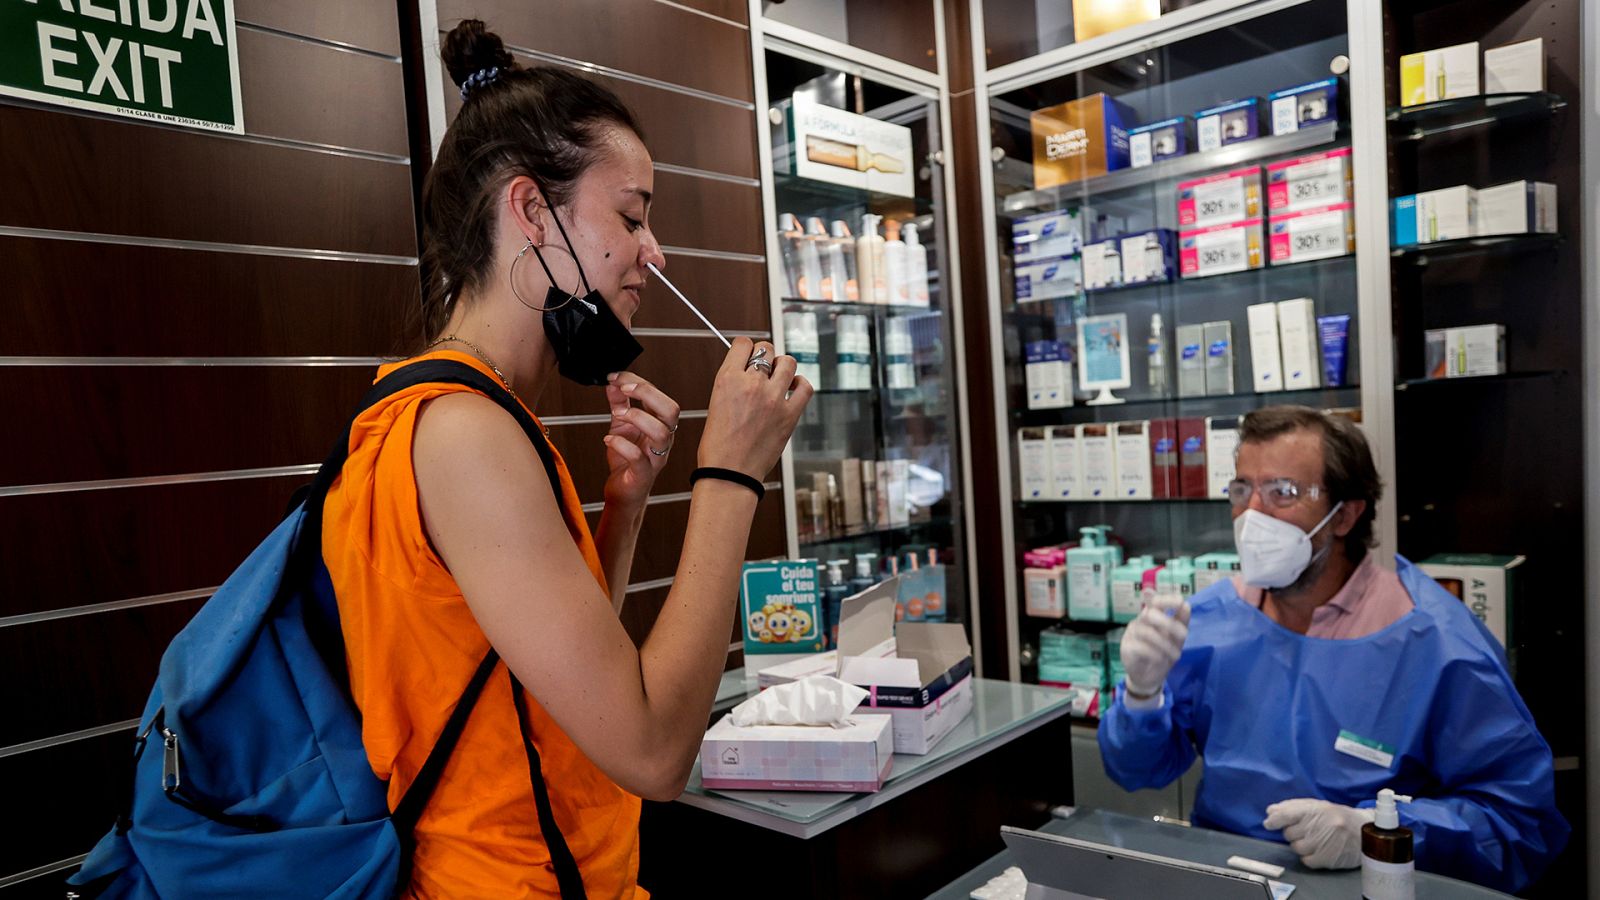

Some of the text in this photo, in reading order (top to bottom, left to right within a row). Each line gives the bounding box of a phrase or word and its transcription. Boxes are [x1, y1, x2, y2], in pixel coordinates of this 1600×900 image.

[37, 20, 182, 109] EXIT
[135, 110, 155, 119] CLASE
[781, 565, 814, 580] Cuida
[782, 579, 815, 592] el teu
[765, 591, 816, 605] somriure
